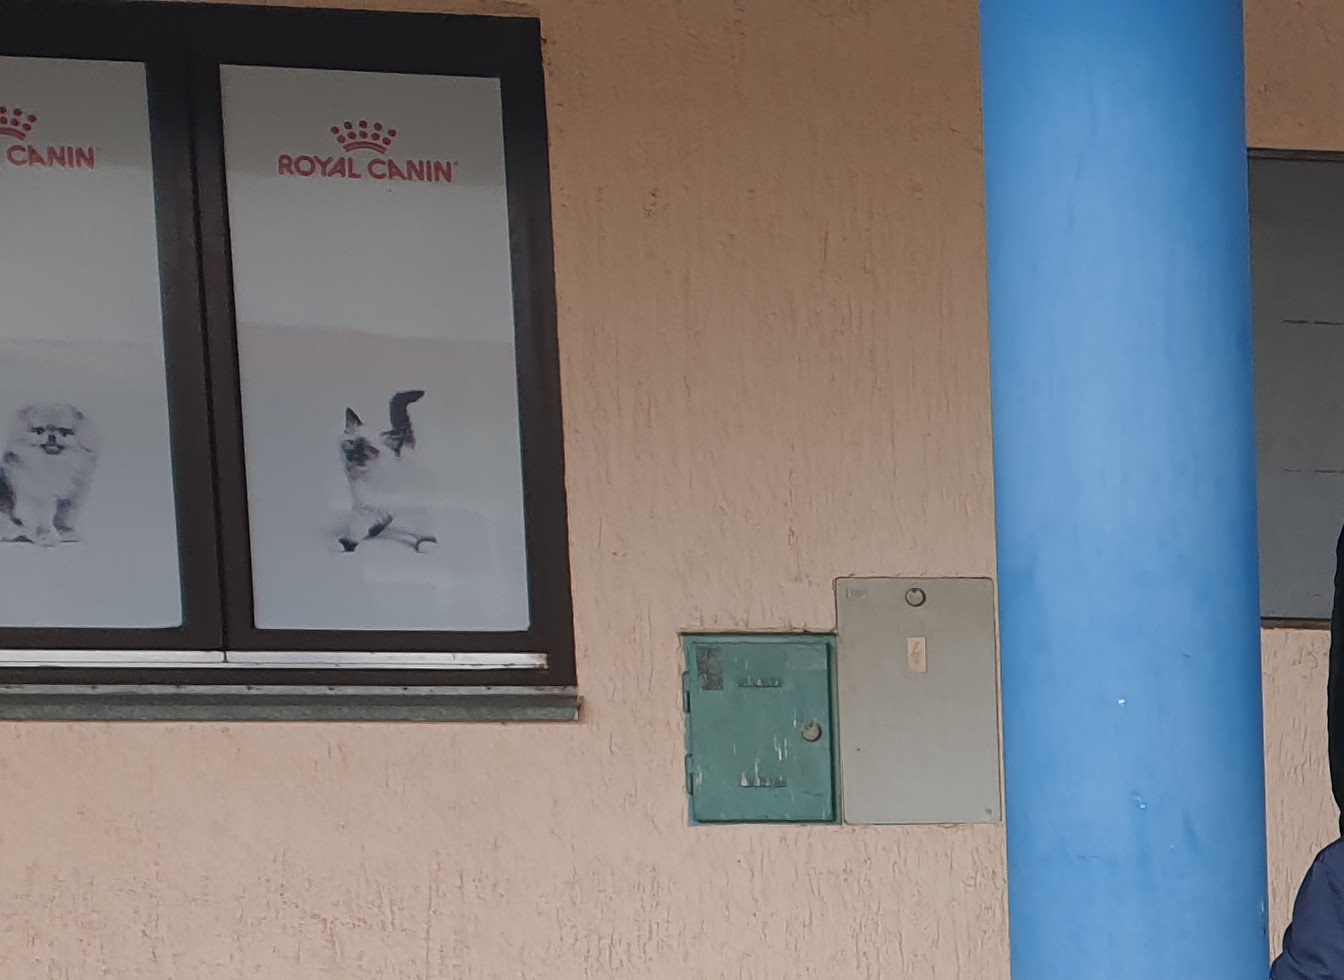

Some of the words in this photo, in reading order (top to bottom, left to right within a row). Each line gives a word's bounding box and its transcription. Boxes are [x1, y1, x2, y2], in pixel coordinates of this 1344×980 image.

[6, 144, 95, 169] CANIN
[278, 154, 362, 179] ROYAL
[367, 158, 452, 182] CANIN
